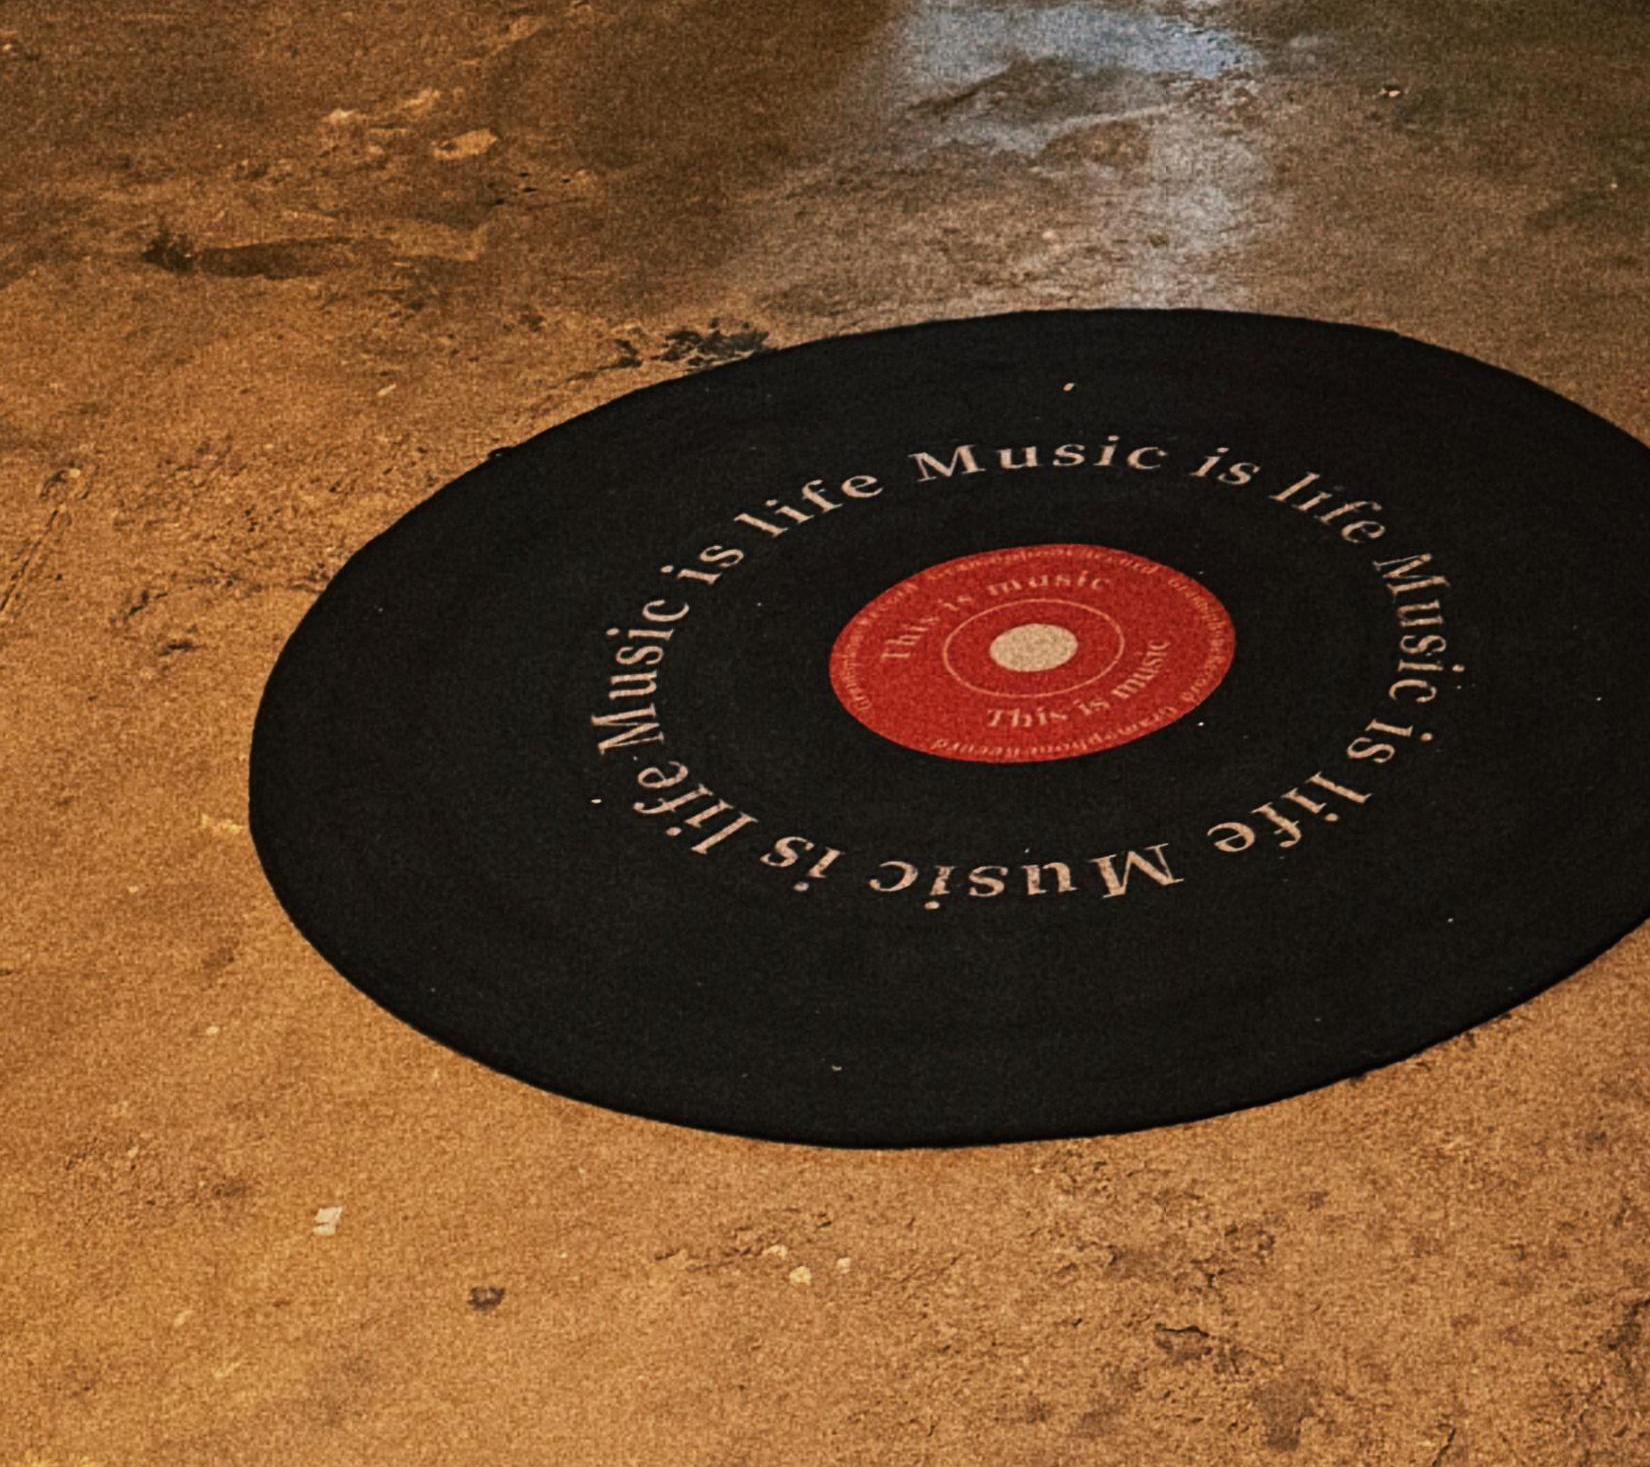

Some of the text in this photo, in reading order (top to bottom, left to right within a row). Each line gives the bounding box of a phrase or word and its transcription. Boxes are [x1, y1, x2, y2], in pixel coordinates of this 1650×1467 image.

[908, 433, 1391, 546] Music is life
[590, 473, 886, 754] Music is life
[880, 569, 1112, 662] This is music
[986, 637, 1172, 729] This is music
[1205, 550, 1467, 858] Music is life
[631, 757, 1186, 911] Music is life
